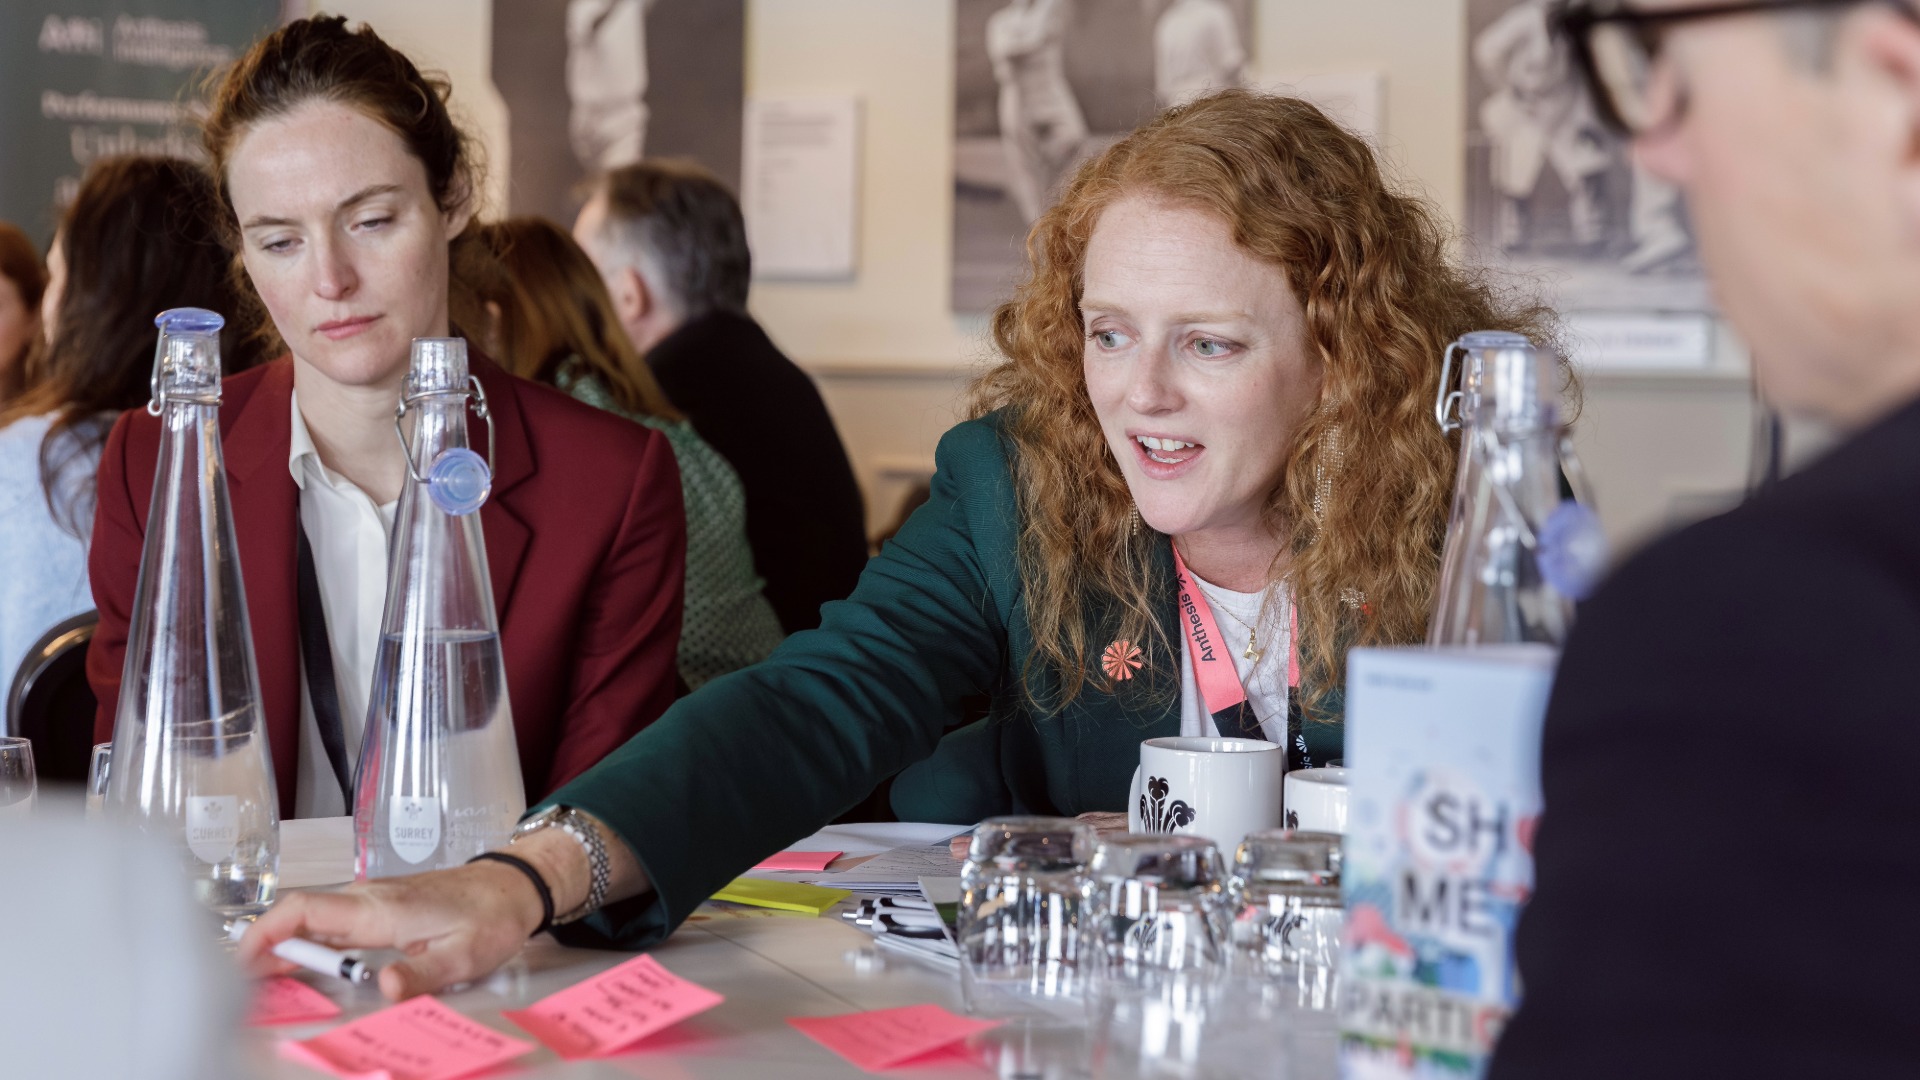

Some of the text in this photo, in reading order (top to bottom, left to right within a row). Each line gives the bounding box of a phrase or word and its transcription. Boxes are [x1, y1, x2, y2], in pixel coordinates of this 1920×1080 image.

[1181, 593, 1217, 662] Anthesis
[394, 827, 434, 840] SURREY
[1401, 868, 1493, 937] ME
